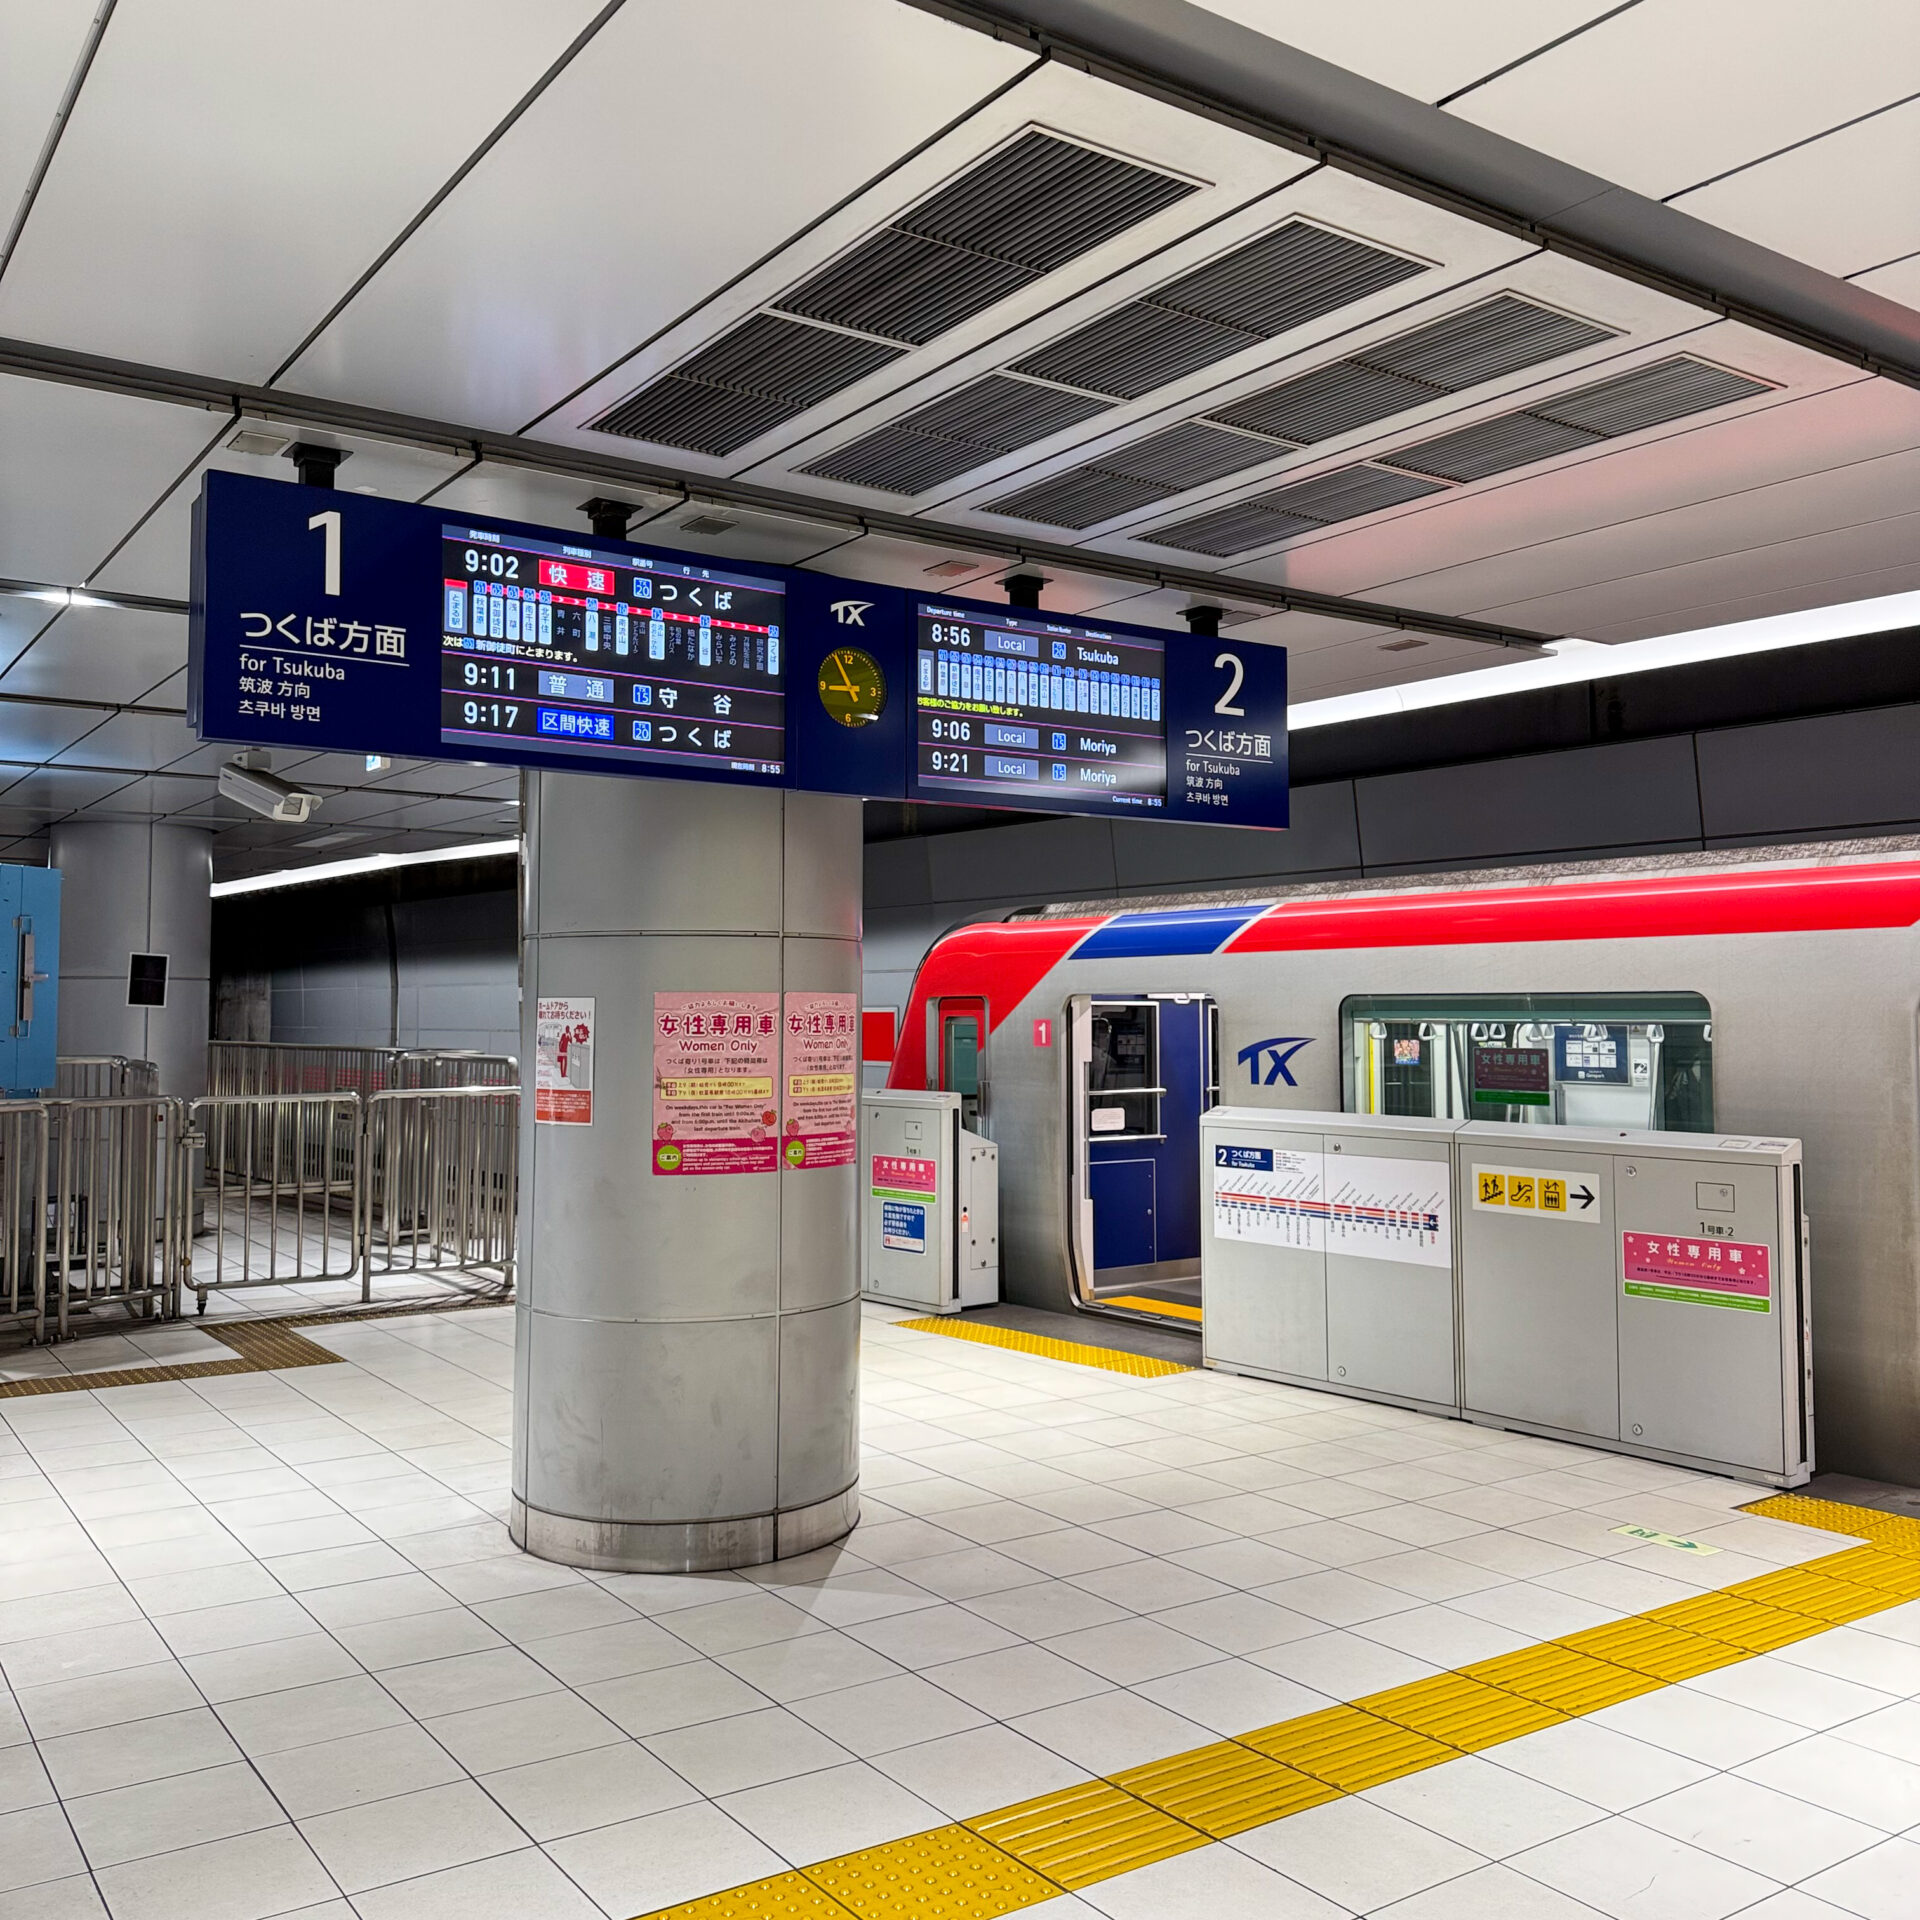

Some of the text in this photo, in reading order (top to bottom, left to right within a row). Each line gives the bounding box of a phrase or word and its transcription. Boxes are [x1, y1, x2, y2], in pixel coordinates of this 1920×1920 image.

[309, 511, 341, 596] 1
[465, 549, 519, 579] 9:02
[549, 565, 605, 591] 快速
[636, 585, 649, 596] 20
[659, 584, 733, 610] つくば
[451, 594, 460, 625] とまる駅
[830, 600, 876, 627] TX
[926, 606, 965, 618] Departure time
[1006, 618, 1018, 627] Type
[240, 612, 407, 658] つくば方面
[442, 635, 463, 647] 次は
[932, 623, 971, 647] 8:56
[998, 635, 1026, 652] Local
[844, 655, 854, 665] 12
[1077, 646, 1119, 665] Tsukuba
[239, 653, 345, 681] for Tsukuba
[464, 662, 515, 691] 9:11
[238, 676, 311, 699] 筑波 方向
[549, 675, 604, 699] 普通
[820, 681, 826, 690] 9
[870, 687, 877, 697] 3
[1214, 653, 1245, 717] 2
[637, 692, 649, 703] 15
[659, 687, 732, 715] 守谷
[238, 699, 321, 722] 츠쿠바 방면
[464, 701, 519, 728] 9:17
[845, 713, 851, 722] 6
[542, 712, 610, 737] 区間快速
[636, 728, 649, 739] 20
[931, 718, 971, 741] 9:06
[659, 726, 732, 749] つくば
[998, 729, 1026, 744] Local
[1055, 739, 1065, 748] 15
[1185, 730, 1271, 758] つくば方面
[1080, 737, 1117, 756] Moriya
[761, 764, 780, 774] 8:55
[931, 751, 968, 773] 9:21
[998, 760, 1026, 775] Local
[1186, 759, 1240, 776] for Tsukuba
[1055, 770, 1065, 779] 15
[1080, 768, 1117, 786] Moriya
[1186, 775, 1223, 790] 筑波 方向
[1186, 792, 1229, 806] 츠쿠바 방면
[659, 1014, 774, 1035] 女性専用車
[1038, 1022, 1046, 1043] 1
[679, 1040, 757, 1053] Women Only
[803, 1039, 834, 1050] Women
[1237, 1037, 1317, 1086] TX
[1218, 1149, 1227, 1165] 2
[1231, 1150, 1261, 1160] つくば方面
[1647, 1241, 1743, 1263] 女性専用車
